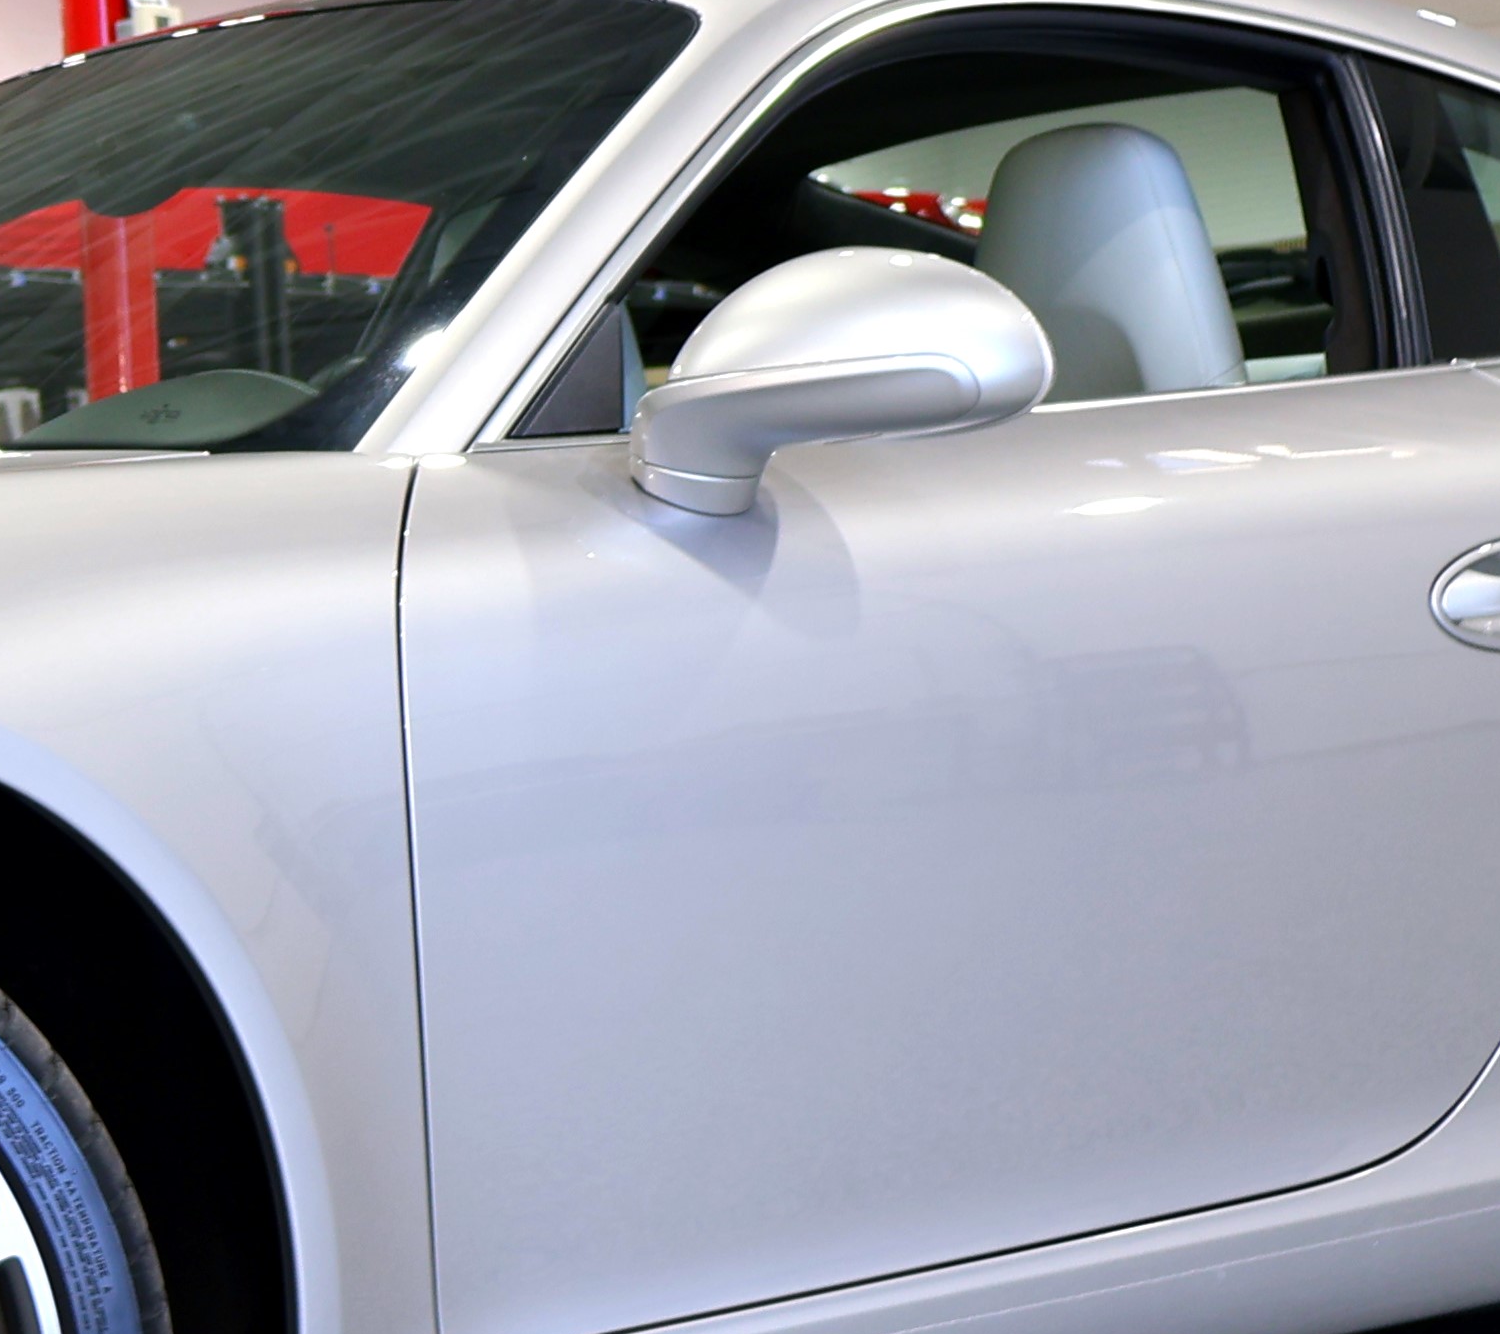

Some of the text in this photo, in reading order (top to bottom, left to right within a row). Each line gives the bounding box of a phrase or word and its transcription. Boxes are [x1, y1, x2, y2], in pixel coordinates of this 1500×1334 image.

[31, 1121, 67, 1174] TRACTION
[63, 1177, 79, 1196] AA
[73, 1196, 109, 1276] TEMPERATURE
